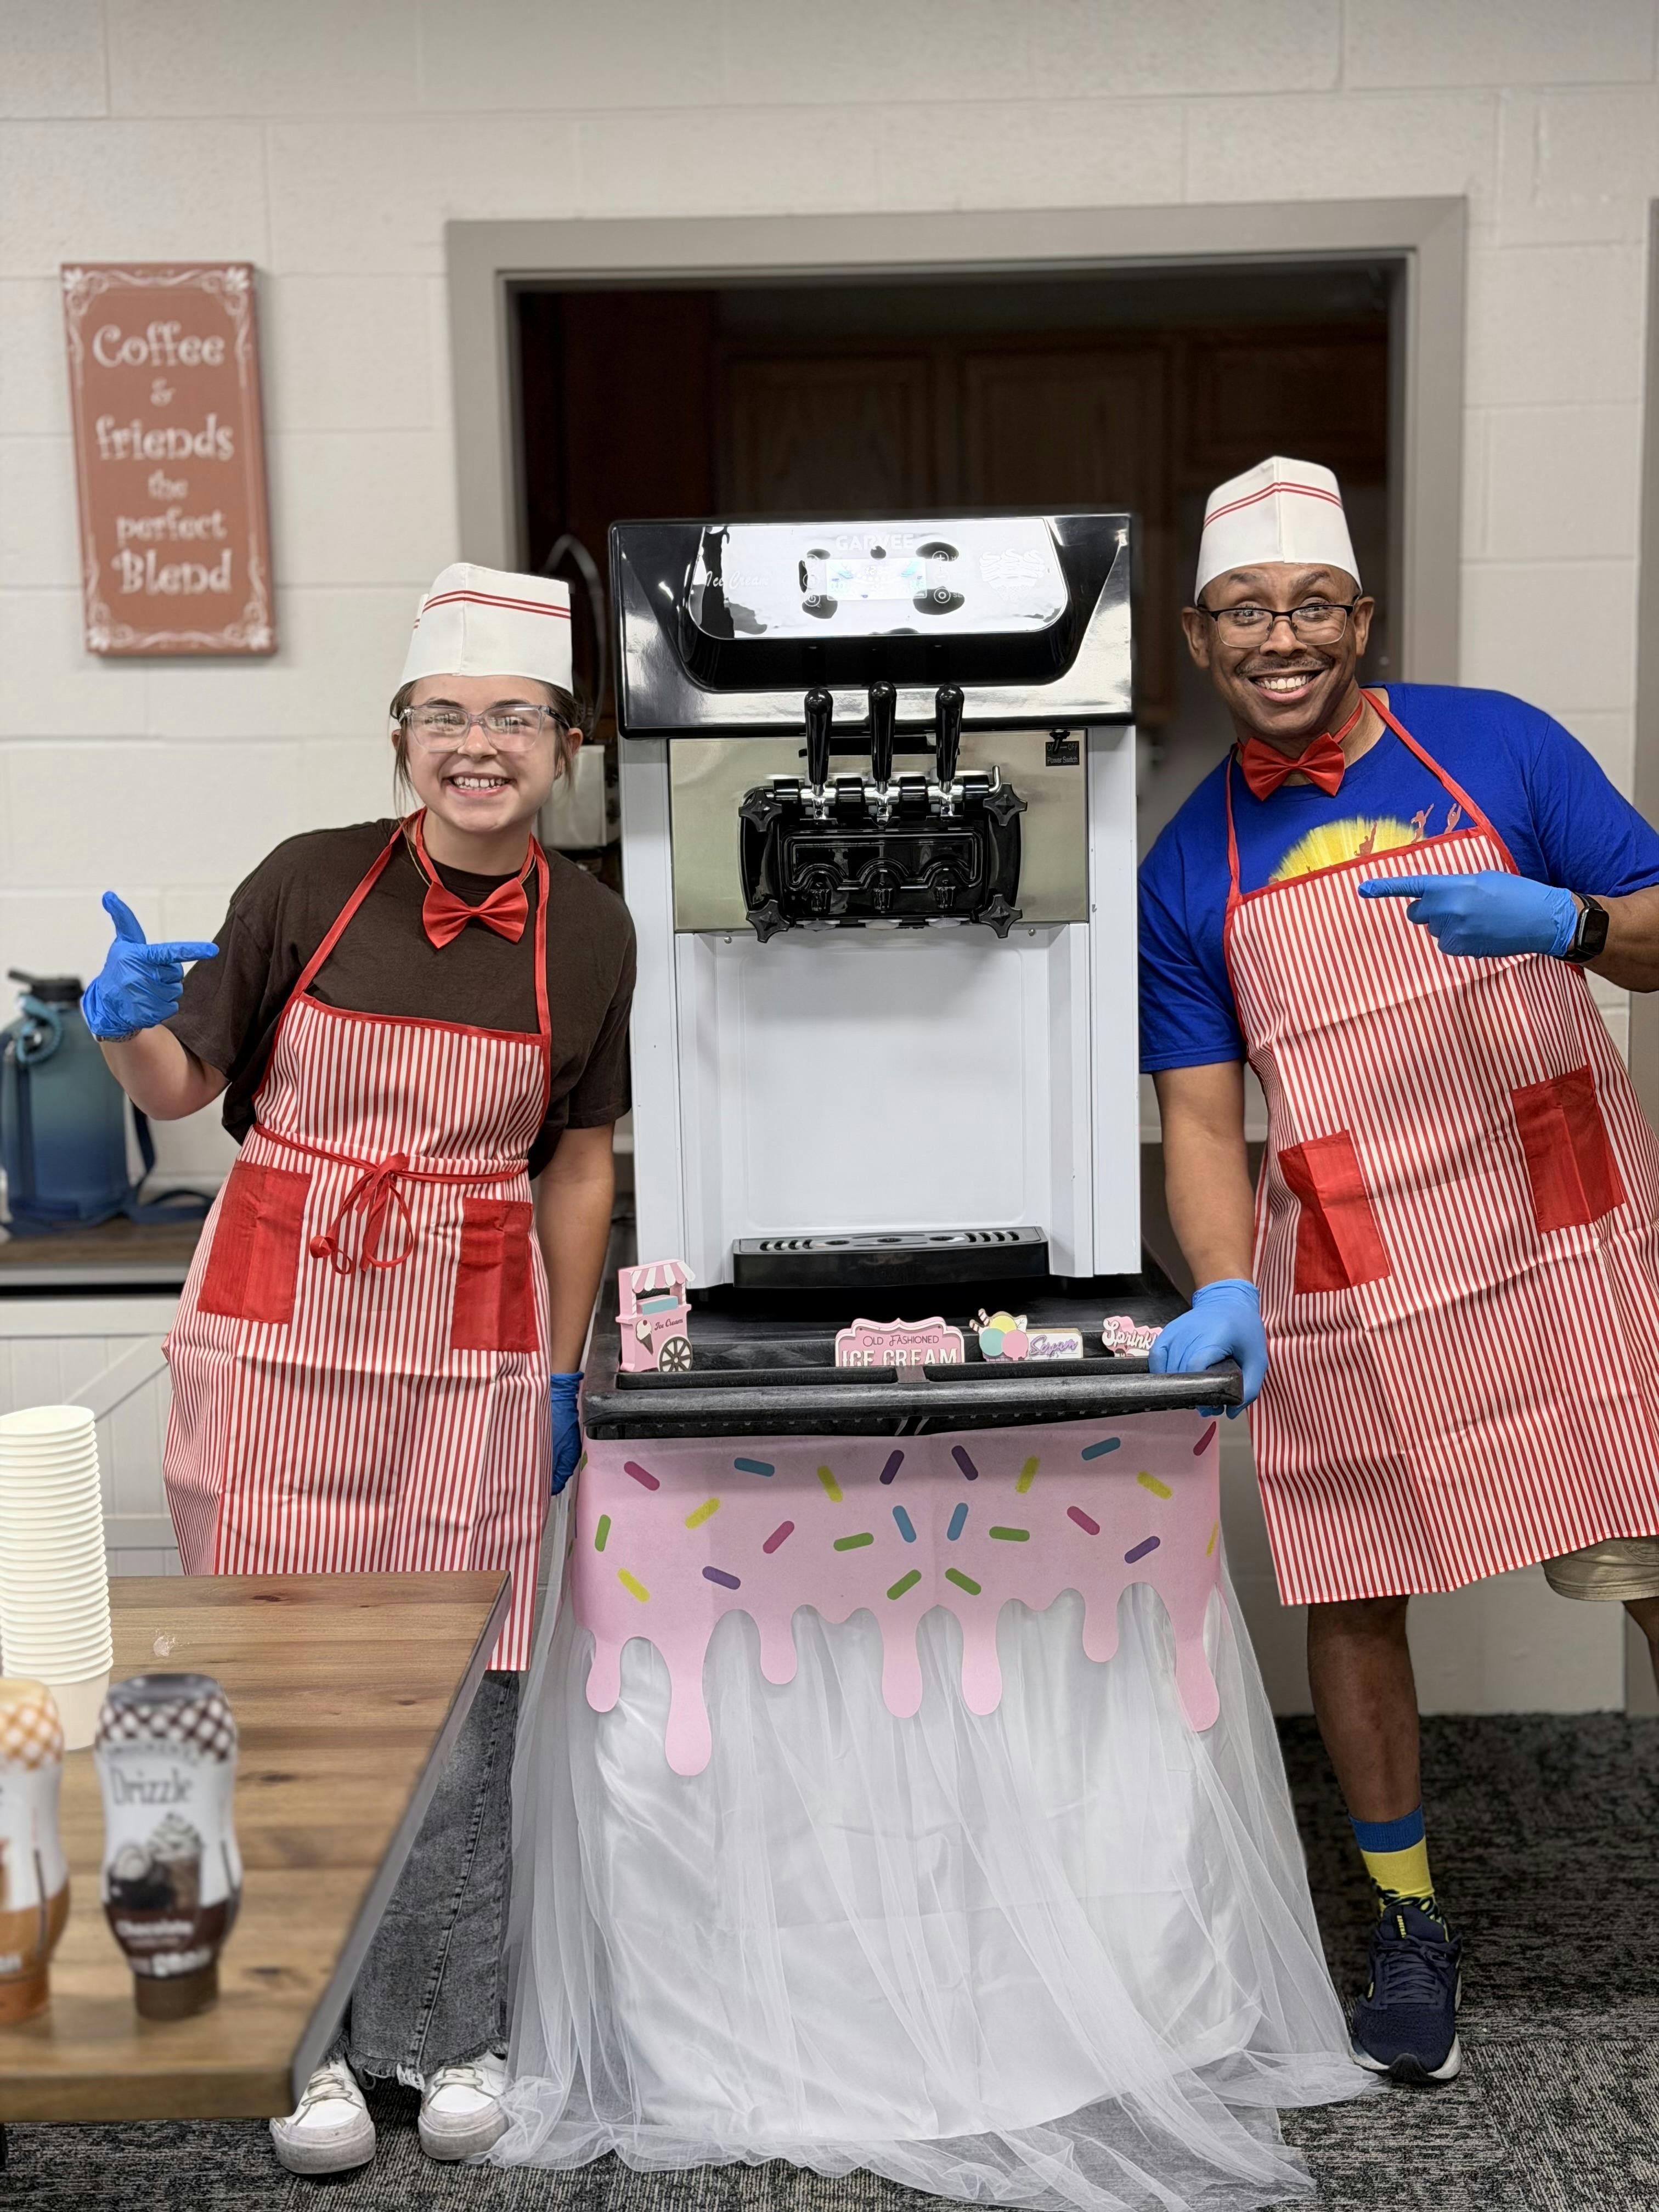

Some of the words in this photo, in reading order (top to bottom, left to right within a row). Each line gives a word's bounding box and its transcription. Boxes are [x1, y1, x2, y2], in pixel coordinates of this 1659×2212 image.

[93, 320, 226, 368] Coffee
[149, 378, 177, 407] &
[95, 413, 235, 461] friends
[148, 469, 190, 500] the
[116, 507, 226, 546] perfect
[835, 533, 914, 550] GARVEE
[111, 548, 233, 595] Blend
[706, 571, 724, 587] Ice
[729, 570, 772, 589] Cream
[654, 1322, 664, 1331] Ice
[665, 1318, 683, 1328] Cream
[862, 1335, 883, 1347] OLD
[889, 1334, 939, 1347] FASHIONED
[842, 1349, 874, 1367] ICE
[882, 1348, 958, 1366] CREAM
[110, 1767, 194, 1807] Drizzle
